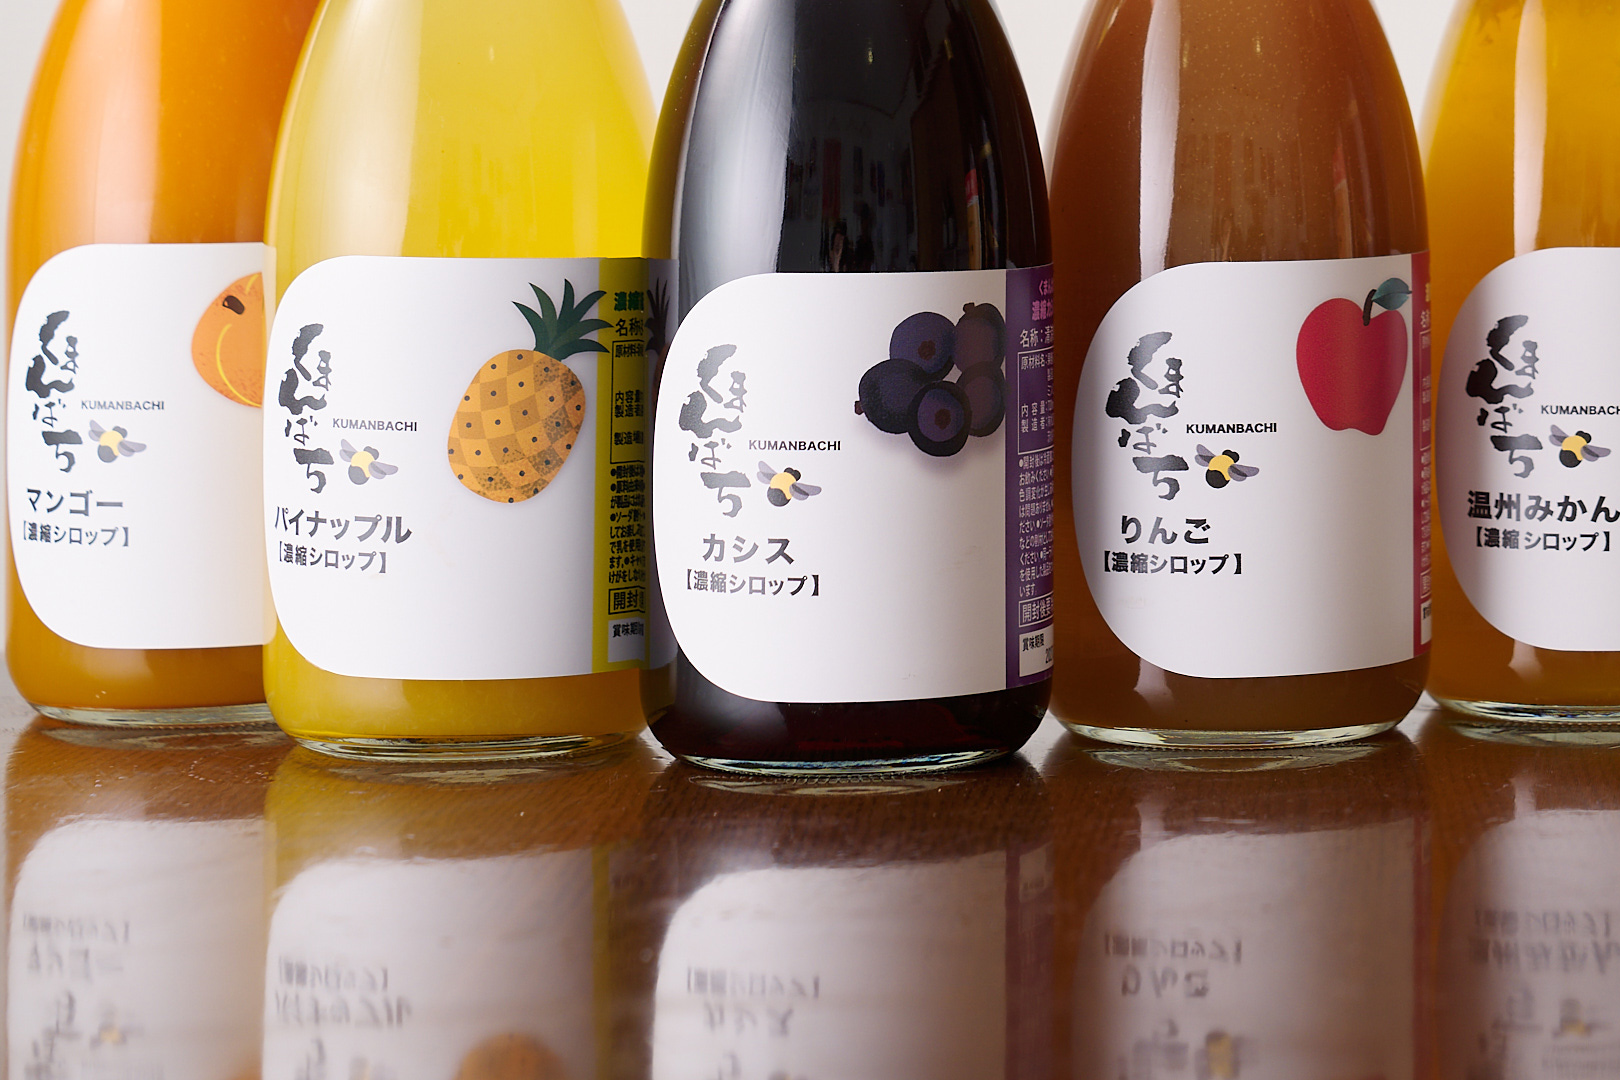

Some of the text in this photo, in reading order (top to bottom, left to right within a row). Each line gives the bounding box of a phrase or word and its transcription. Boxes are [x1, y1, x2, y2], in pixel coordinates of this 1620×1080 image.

[80, 399, 165, 411] KUMANBACHI
[332, 417, 419, 432] KUMANBACHI
[1185, 421, 1278, 434] KUMANBACHI
[748, 439, 842, 452] KUMANBACHI
[26, 487, 124, 517] マンゴー
[1467, 489, 1620, 524] 温州みかん
[275, 506, 413, 545] パイナップル
[1119, 514, 1211, 546] りんご
[702, 532, 795, 565] カシス
